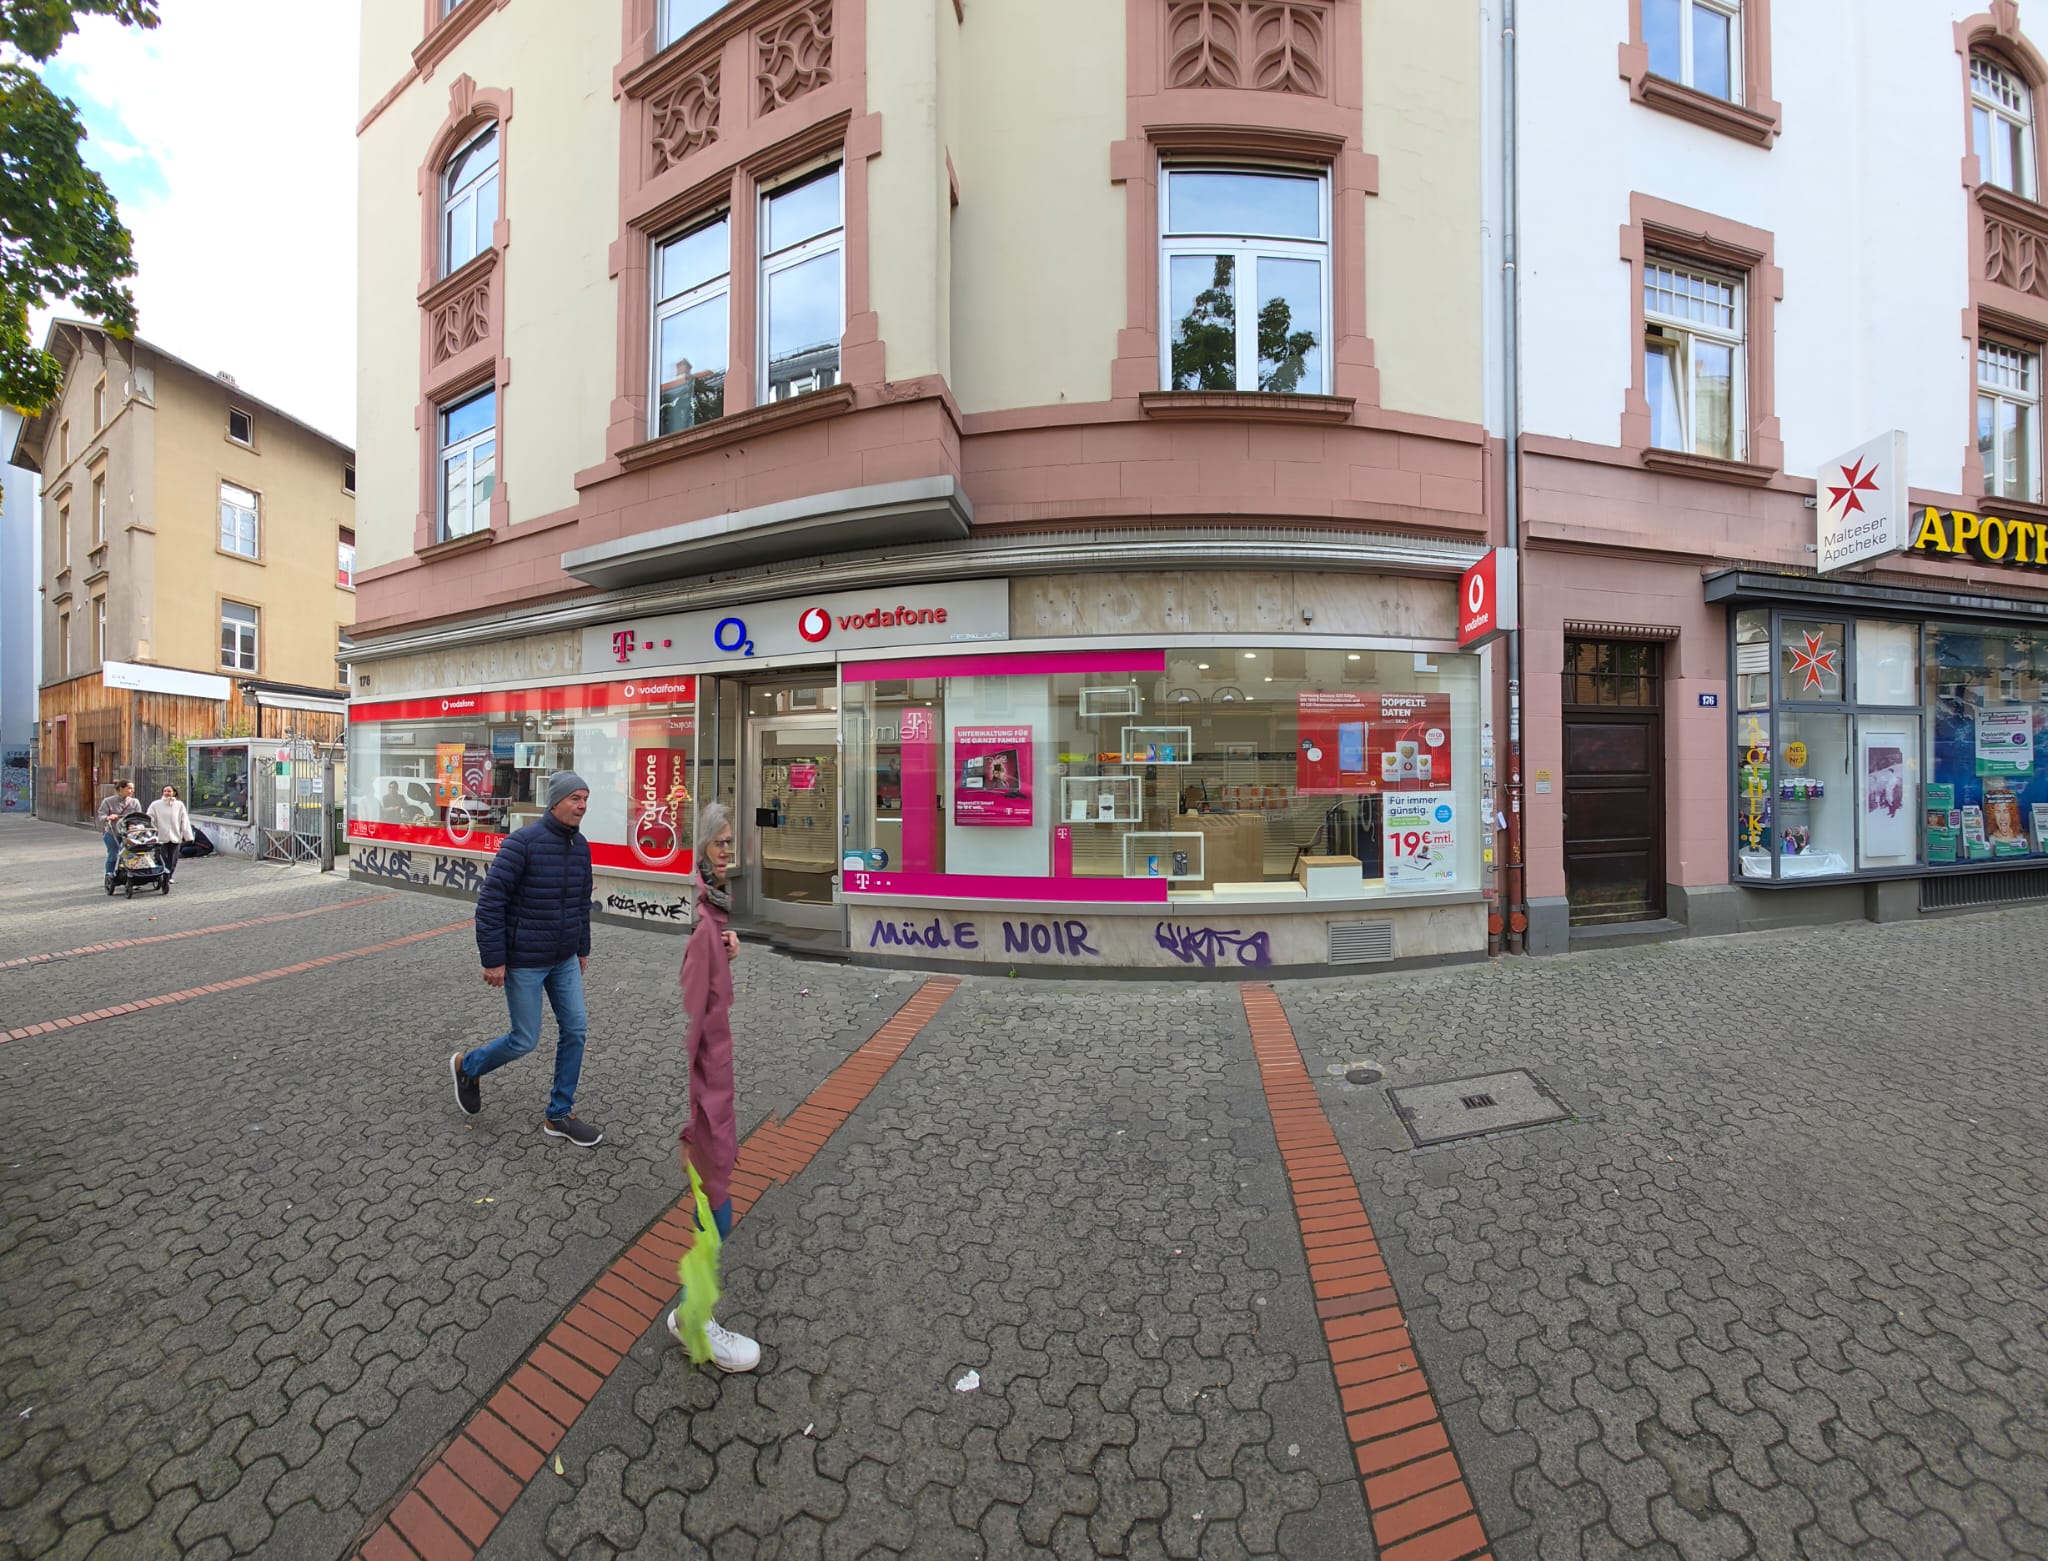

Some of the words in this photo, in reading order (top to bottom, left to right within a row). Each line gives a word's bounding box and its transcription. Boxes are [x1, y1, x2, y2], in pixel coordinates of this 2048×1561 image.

[1824, 517, 1887, 547] Malteser
[1824, 533, 1887, 563] Apotheke
[837, 605, 947, 630] vodafone
[1464, 613, 1488, 632] vodafone
[639, 684, 686, 694] vodafone
[450, 699, 474, 708] vodafone
[1381, 699, 1427, 708] DOPPELTE
[1702, 695, 1714, 705] 176
[1381, 708, 1411, 717] DATEN
[1747, 717, 1764, 849] APOTHEKE
[641, 755, 656, 830] vodafone
[1389, 796, 1404, 805] Für
[1407, 796, 1437, 804] immer
[1390, 806, 1429, 816] günstig.
[1434, 831, 1454, 844] mtl.
[1002, 919, 1099, 956] NOIR
